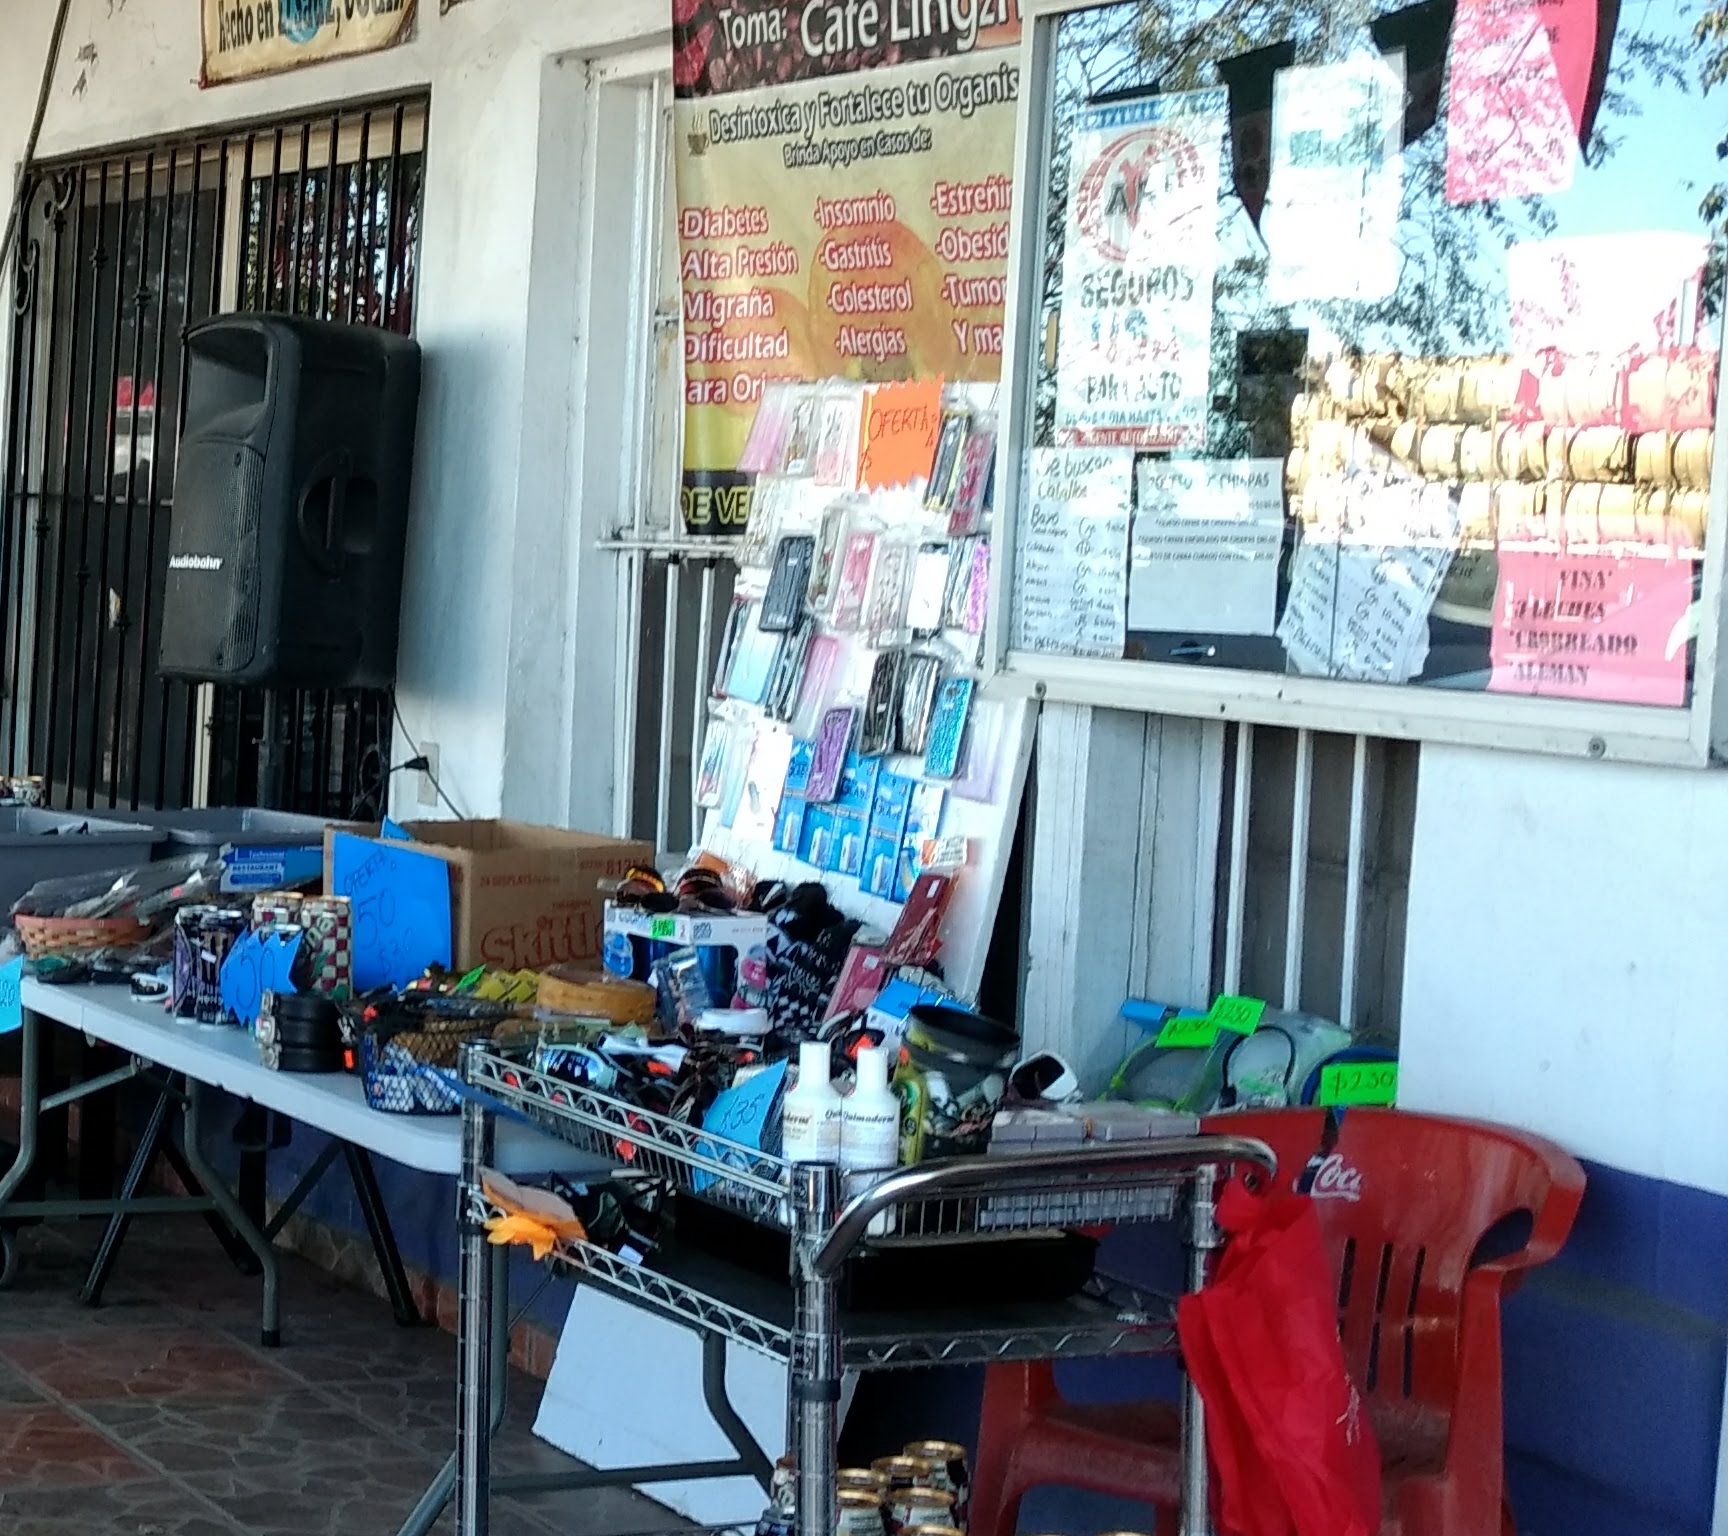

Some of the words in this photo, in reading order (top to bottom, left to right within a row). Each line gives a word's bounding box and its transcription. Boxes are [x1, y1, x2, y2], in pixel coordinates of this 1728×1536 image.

[256, 0, 275, 41] en
[718, 5, 790, 51] Toma:
[709, 100, 802, 145] Desintoxica
[803, 102, 817, 141] y
[818, 82, 905, 129] Fortalece
[906, 79, 931, 116] tu
[934, 61, 1019, 117] Organis
[783, 138, 821, 169] Brinda
[822, 135, 859, 168] Apoyo
[860, 136, 876, 158] en
[876, 129, 910, 154] Casos
[683, 250, 731, 280] Alta
[735, 243, 800, 277] Presión
[935, 223, 1010, 263] -Obesid
[683, 288, 775, 327] Migraña
[683, 329, 790, 362] Dificultad
[951, 322, 969, 353] Y
[973, 327, 1003, 355] ma
[169, 555, 223, 570] Audiobahn
[480, 912, 604, 969] Skittl
